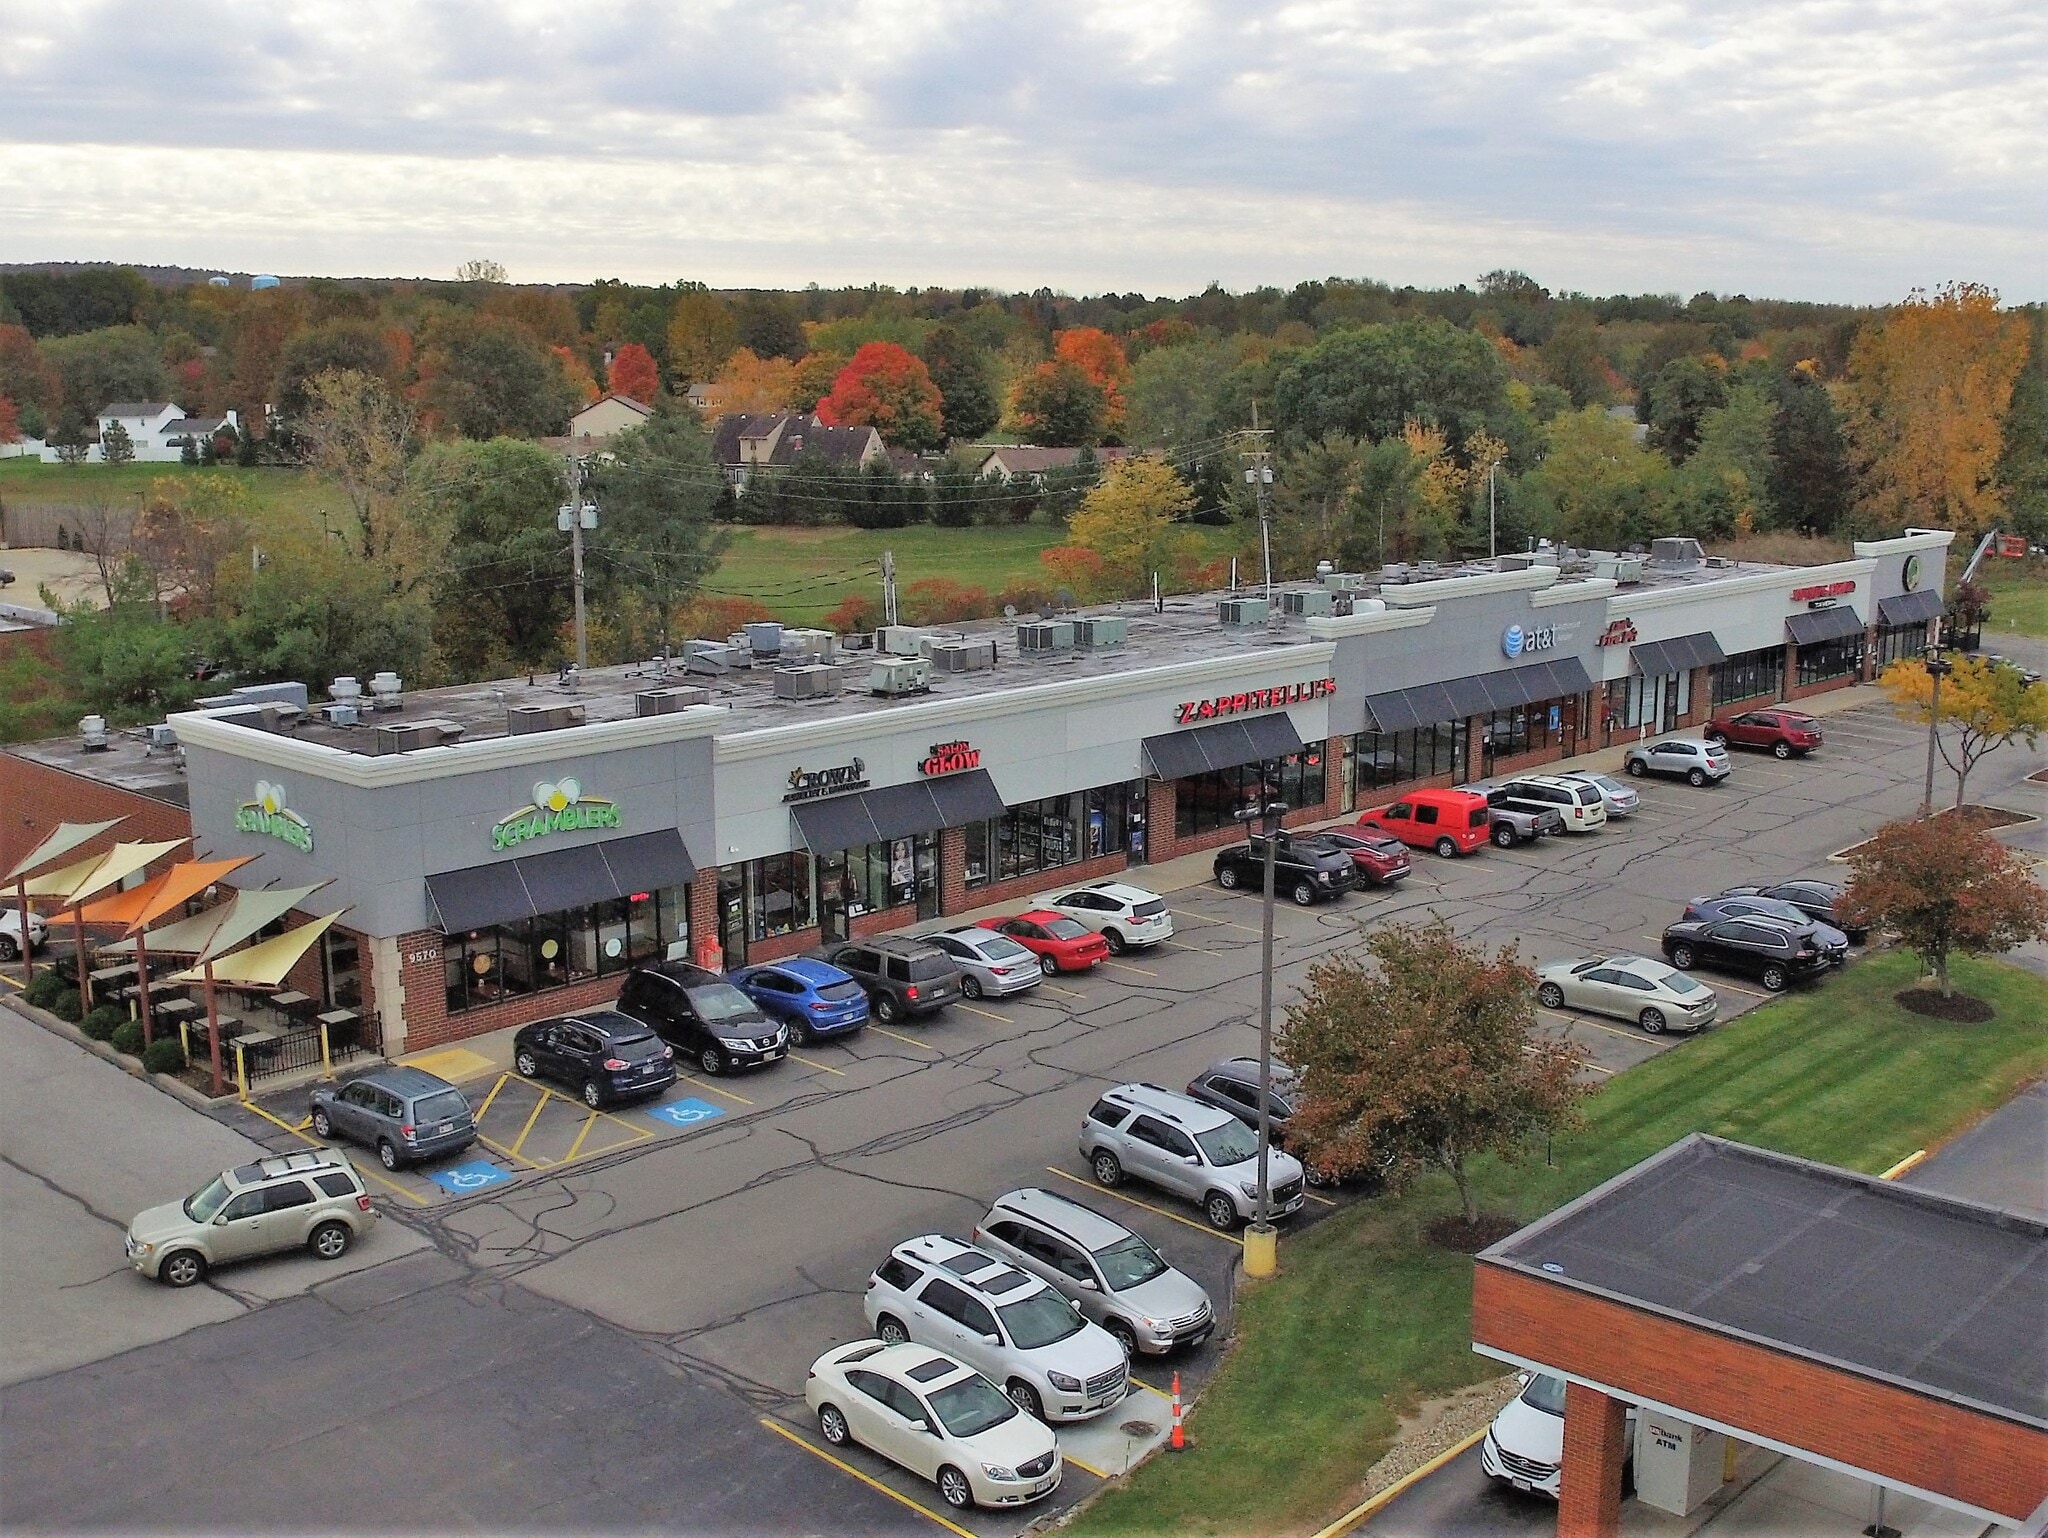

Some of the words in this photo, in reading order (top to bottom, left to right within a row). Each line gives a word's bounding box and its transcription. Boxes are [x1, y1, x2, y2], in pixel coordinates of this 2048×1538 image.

[1525, 624, 1558, 652] at&t
[922, 750, 981, 776] GLOW
[795, 765, 861, 791] CROWN
[491, 803, 622, 852] SCRAMBLERS
[409, 949, 437, 962] 9570
[1656, 1438, 1676, 1451] ATM
